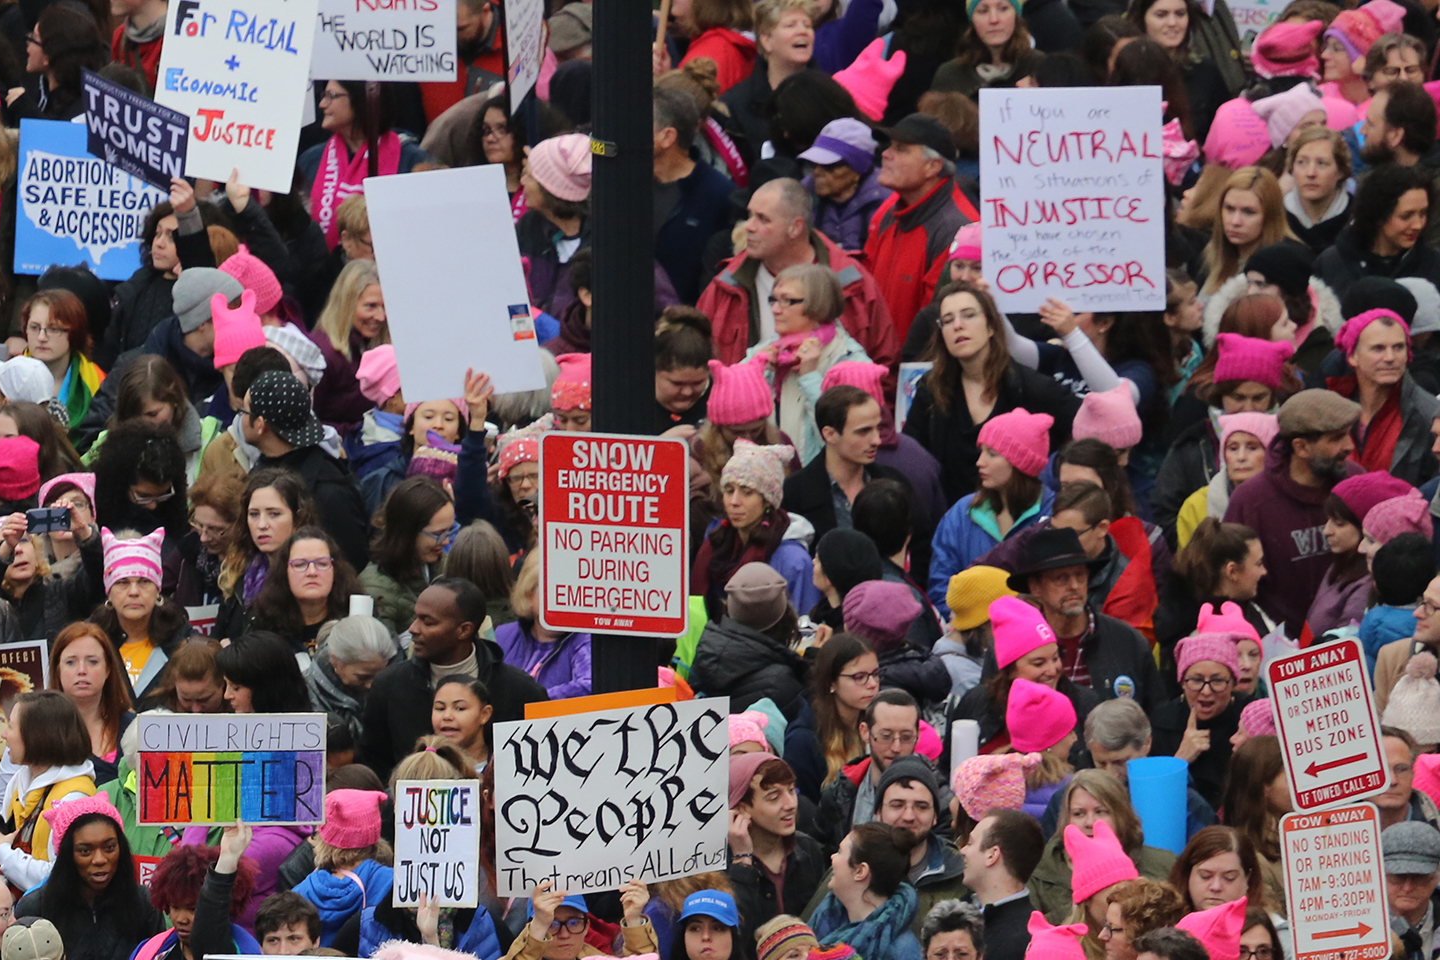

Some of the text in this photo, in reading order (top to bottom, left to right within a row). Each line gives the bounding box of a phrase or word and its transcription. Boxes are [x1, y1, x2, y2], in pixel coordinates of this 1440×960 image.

[335, 24, 435, 52] WORLD IS
[367, 52, 454, 75] WATCHING
[165, 68, 258, 103] ECONOMIC
[84, 84, 185, 152] TRUST
[193, 108, 275, 151] JUSTICE
[87, 111, 182, 179] WOMEN
[994, 129, 1160, 167] NEUTRAL
[28, 158, 119, 185] ABORTION:
[25, 185, 92, 208] SAFE,
[984, 196, 1149, 228] INJUSTICE
[996, 260, 1155, 294] OPRESSOR
[572, 440, 654, 471] SNOW
[558, 469, 669, 493] EMERGENCY
[568, 492, 659, 523] ROUTE
[555, 528, 673, 556] NO PARKING
[578, 558, 649, 582] DURING
[556, 584, 672, 612] EMERGENCY
[594, 617, 634, 627] TOW AWAY
[1278, 647, 1347, 677] TOW AWAY
[1284, 668, 1353, 699] NO PARKING
[1301, 685, 1360, 715] STANDING
[143, 722, 321, 750] CIVIL RIGHTS
[1306, 709, 1349, 734] METRO
[1295, 724, 1366, 757] BUS ZONE
[143, 759, 318, 820] MATTER
[1311, 773, 1381, 804] TOWED CALL 311
[403, 787, 472, 829] JUSTICE
[501, 775, 724, 862] People
[1291, 809, 1367, 829] TOW AWAY
[420, 828, 450, 854] NOT
[1292, 829, 1370, 854] NO STANDING
[639, 847, 682, 881] ALL
[1295, 849, 1371, 873] OR PARKING
[398, 860, 465, 903] JUST US
[1298, 869, 1373, 893] 7AM-9:30AM
[1299, 889, 1375, 913] 4PM-6:30PM
